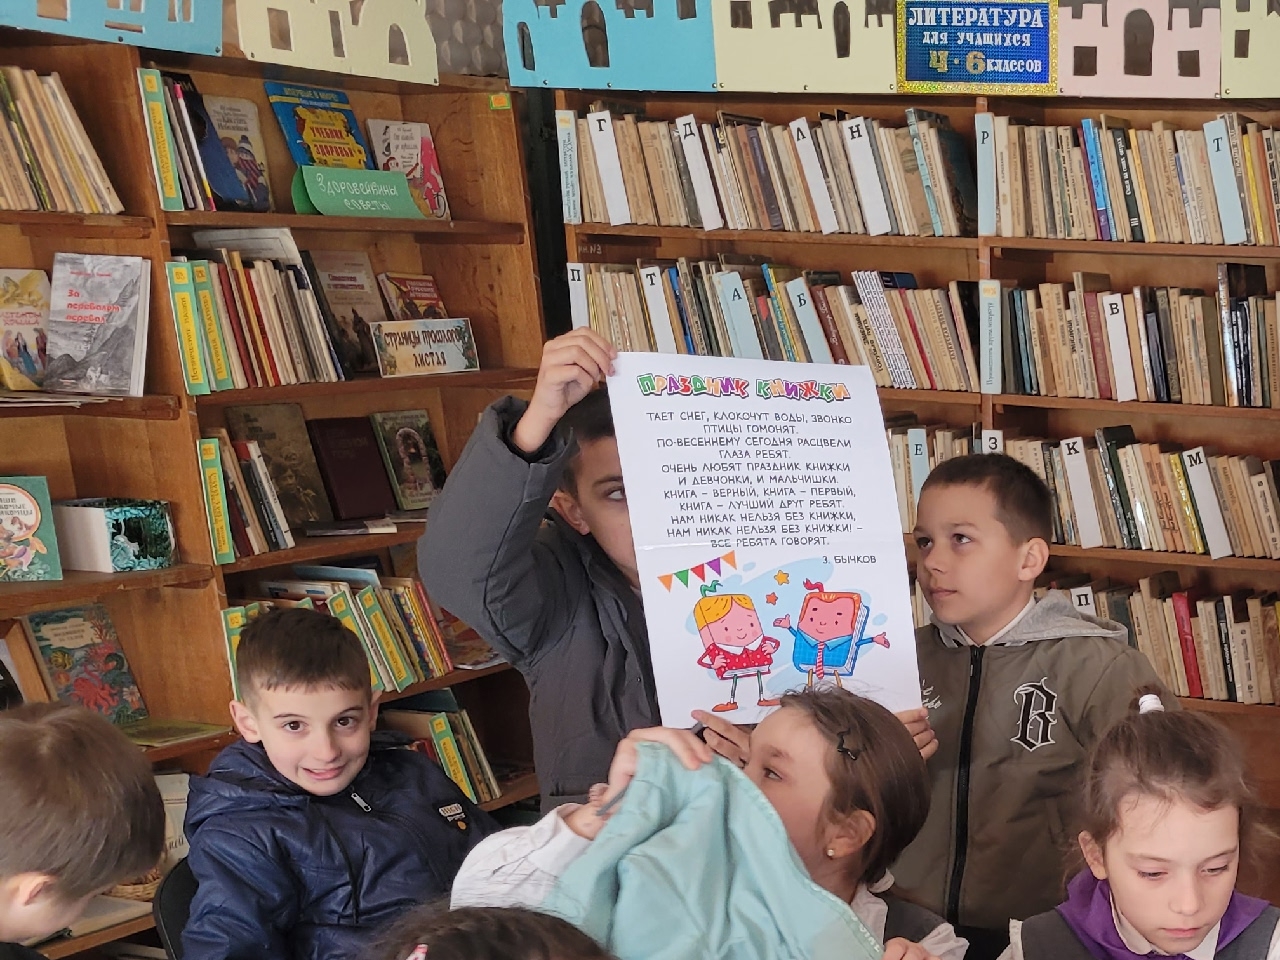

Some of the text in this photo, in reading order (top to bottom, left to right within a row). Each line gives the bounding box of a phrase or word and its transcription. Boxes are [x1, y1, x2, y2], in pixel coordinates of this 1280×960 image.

[908, 7, 1044, 28] ЛИТЕРАТУРА
[596, 118, 607, 132] Г
[682, 122, 697, 140] Д
[847, 124, 863, 140] Н
[795, 127, 807, 142] Л
[981, 130, 990, 145] Р
[1212, 136, 1223, 152] Т
[570, 268, 582, 282] П
[645, 273, 657, 287] Т
[731, 287, 743, 302] А
[796, 292, 807, 308] Б
[1109, 302, 1120, 316] В
[636, 372, 851, 403] ПРАЗДНИК КНИЖКИ
[646, 411, 853, 424] ТАЕТ СНЕГ, КЛОКОЧУТ ВОДЫ, ЗВОНКО
[703, 424, 799, 435] ПТИЦЫ ГОМОНЯТ.
[657, 437, 852, 449] ПО-ВЕСЕННЕМУ СЕГОДНЯ РАСЦВЕЛИ
[914, 443, 923, 456] Е
[1065, 441, 1080, 456] К
[719, 450, 791, 459] ГЛАЗА РЕБЯТ.
[1187, 450, 1204, 468] М
[661, 462, 851, 474] ОЧЕНЬ ЛЮБЯТ ПРАЗДНИК КНИЖКИ
[678, 475, 839, 486] И ДЕВЧОНКИ, И МАЛЬЧИШКИ.
[664, 485, 856, 500] КНИГА ВЕРНЫЙ, КНИГА ПЕРВЫЙ,
[679, 498, 845, 511] КНИГА ЛУЧШИЙ ДРУГ РЕБЯТ.
[671, 511, 856, 525] НАМ НИКАК НЕЛЬЗЯ БЕЗ КНИЖКИ,
[666, 524, 853, 538] НАМ НИКАК НЕЛЬЗЯ БЕЗ КНИЖКИ!
[711, 536, 831, 548] ВСЕ РЕБЯТА ГОВОРЯТ.
[834, 555, 877, 564] БЫЧКОВ
[1076, 593, 1091, 606] П
